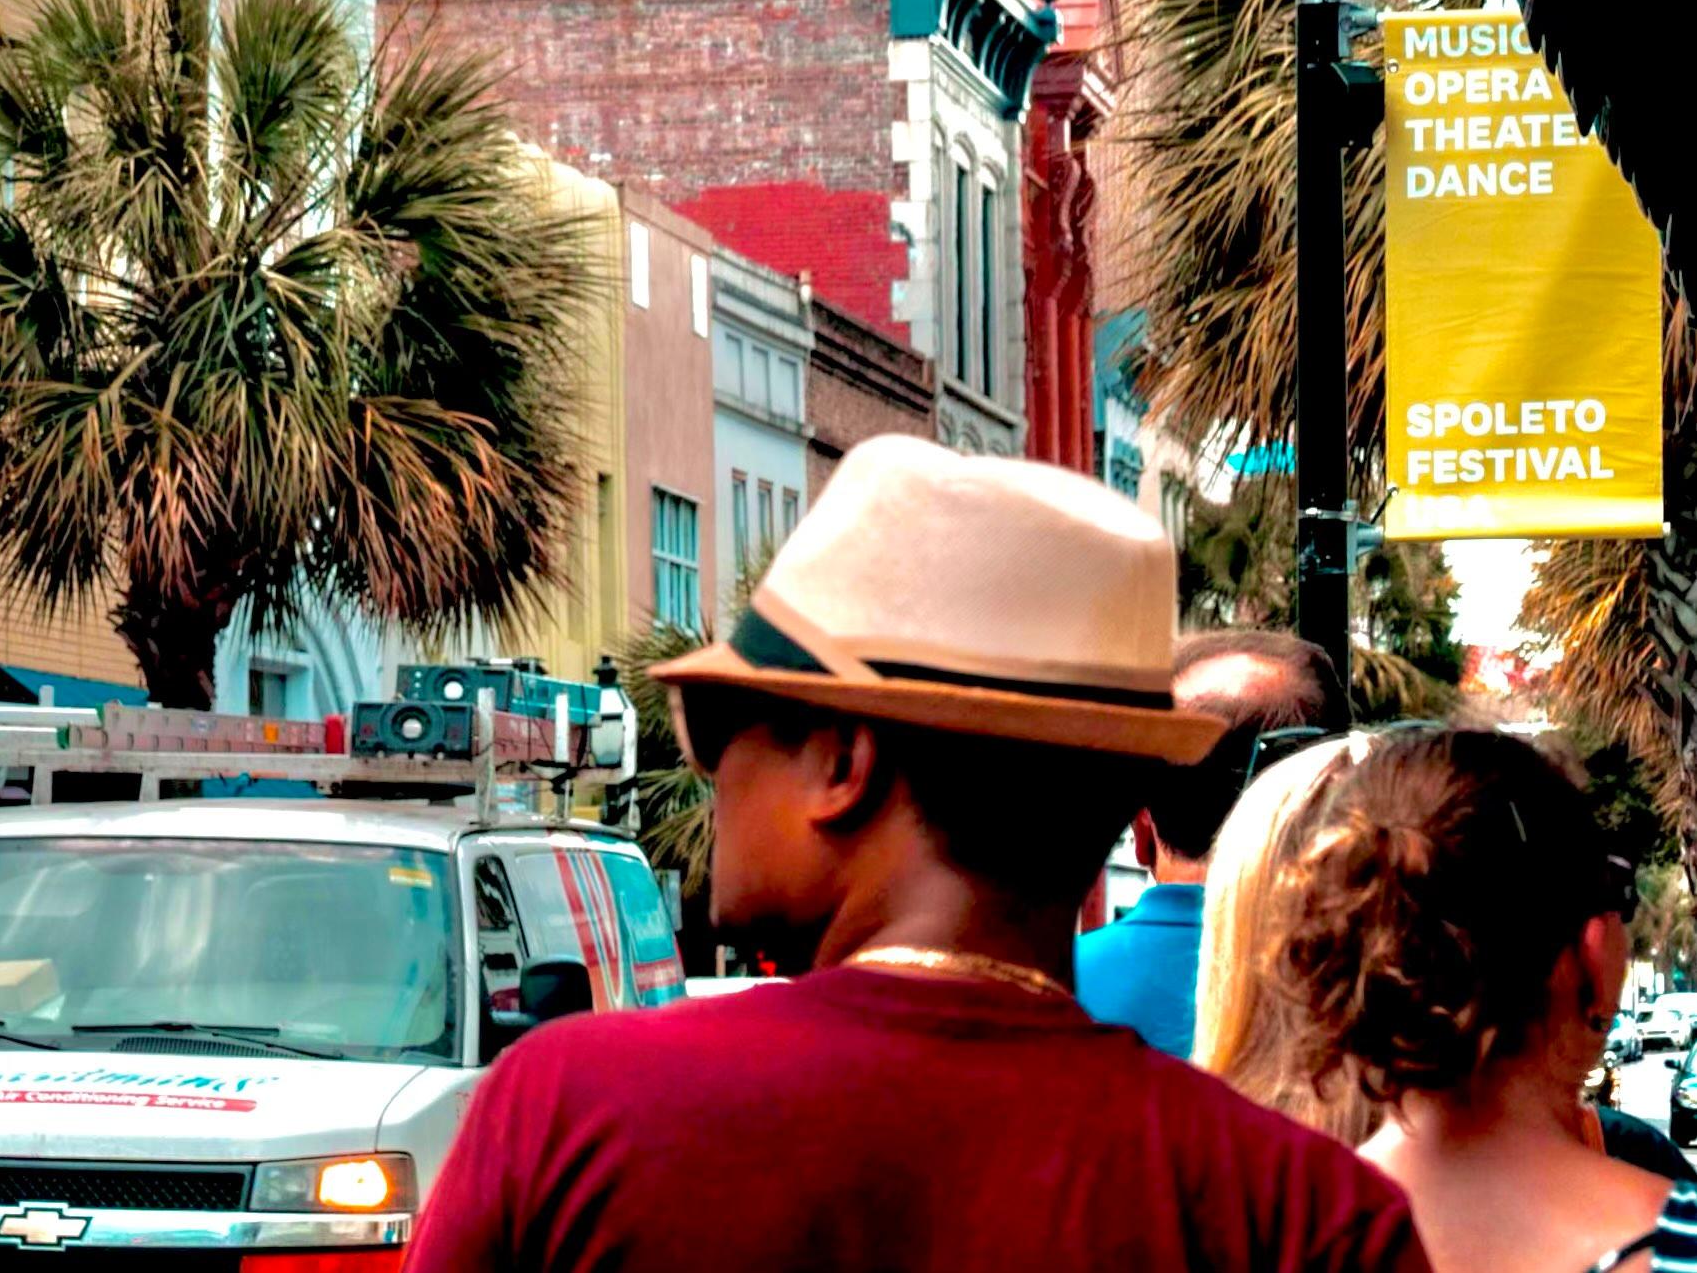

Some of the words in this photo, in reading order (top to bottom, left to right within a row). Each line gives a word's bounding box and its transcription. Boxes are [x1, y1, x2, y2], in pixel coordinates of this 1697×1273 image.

[1404, 67, 1553, 105] OPERA
[1404, 112, 1597, 152] THEATE
[1406, 161, 1554, 199] DANCE
[1406, 398, 1606, 438] SPOLETO
[1407, 445, 1614, 485] FESTIVAL
